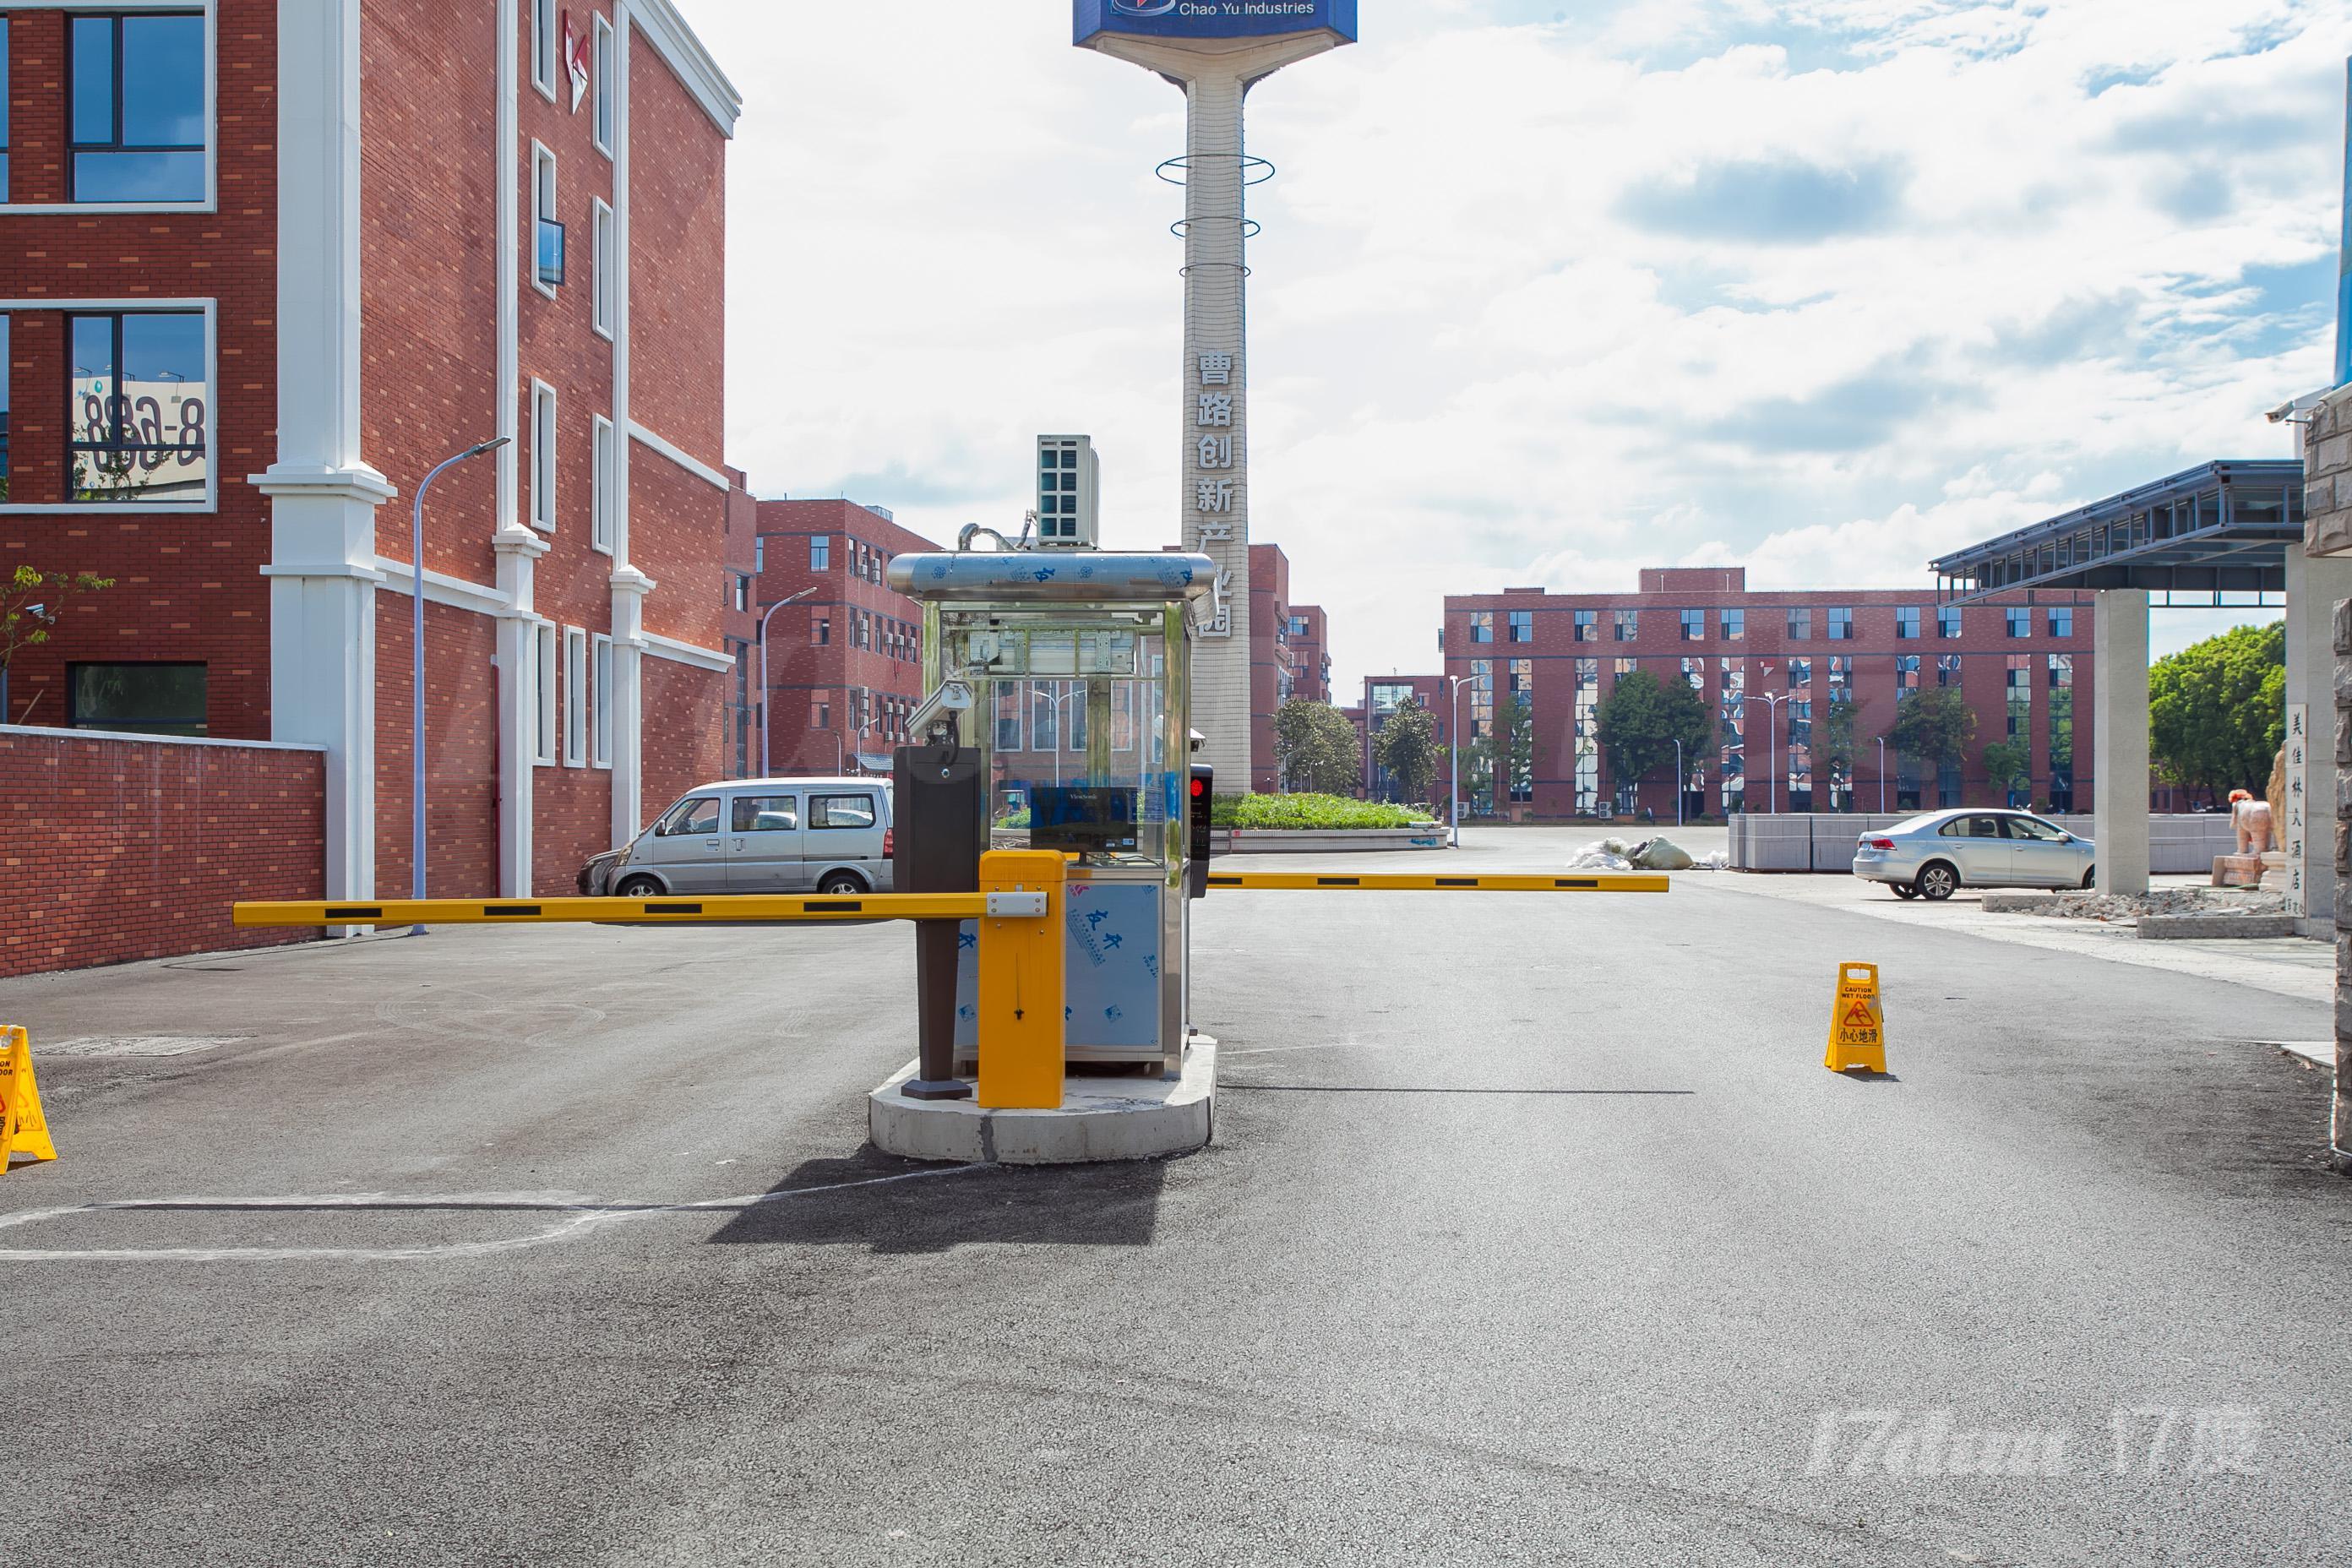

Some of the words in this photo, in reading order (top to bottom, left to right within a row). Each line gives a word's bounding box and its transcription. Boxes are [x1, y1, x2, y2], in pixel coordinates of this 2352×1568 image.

[1179, 3, 1217, 15] Chao
[1222, 3, 1239, 14] Yu
[1244, 3, 1315, 14] Industries
[1839, 1027, 1878, 1043] 小心地滑
